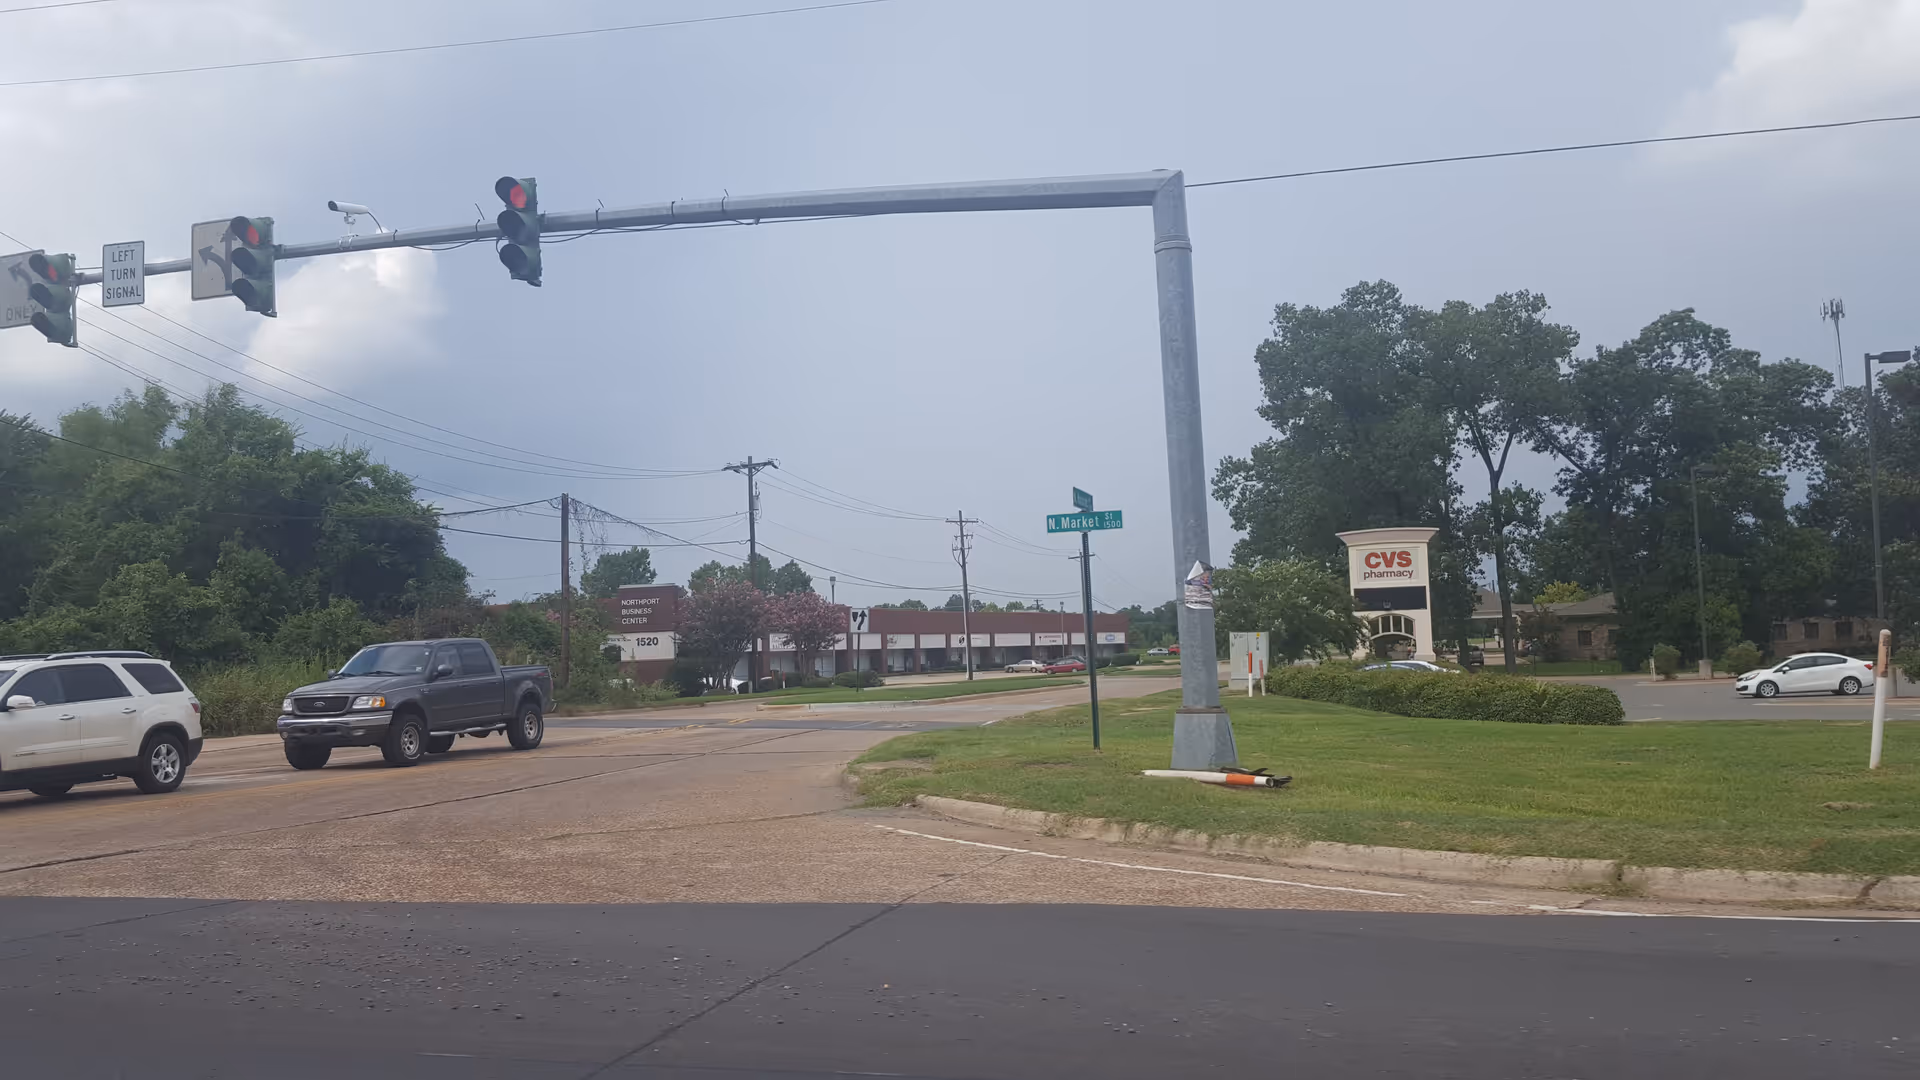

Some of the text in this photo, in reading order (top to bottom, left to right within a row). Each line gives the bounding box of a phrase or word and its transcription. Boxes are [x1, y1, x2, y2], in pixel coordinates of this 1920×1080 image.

[112, 249, 135, 262] LEFT
[111, 267, 136, 281] TURN
[106, 285, 141, 299] SIGNAL
[1048, 518, 1059, 530] N.
[1061, 516, 1099, 529] Market
[1104, 520, 1121, 528] 1500
[1364, 550, 1412, 569] CVS
[1363, 569, 1414, 580] pharmacy
[621, 598, 660, 606] NORTHPORT
[636, 636, 659, 646] 1520
